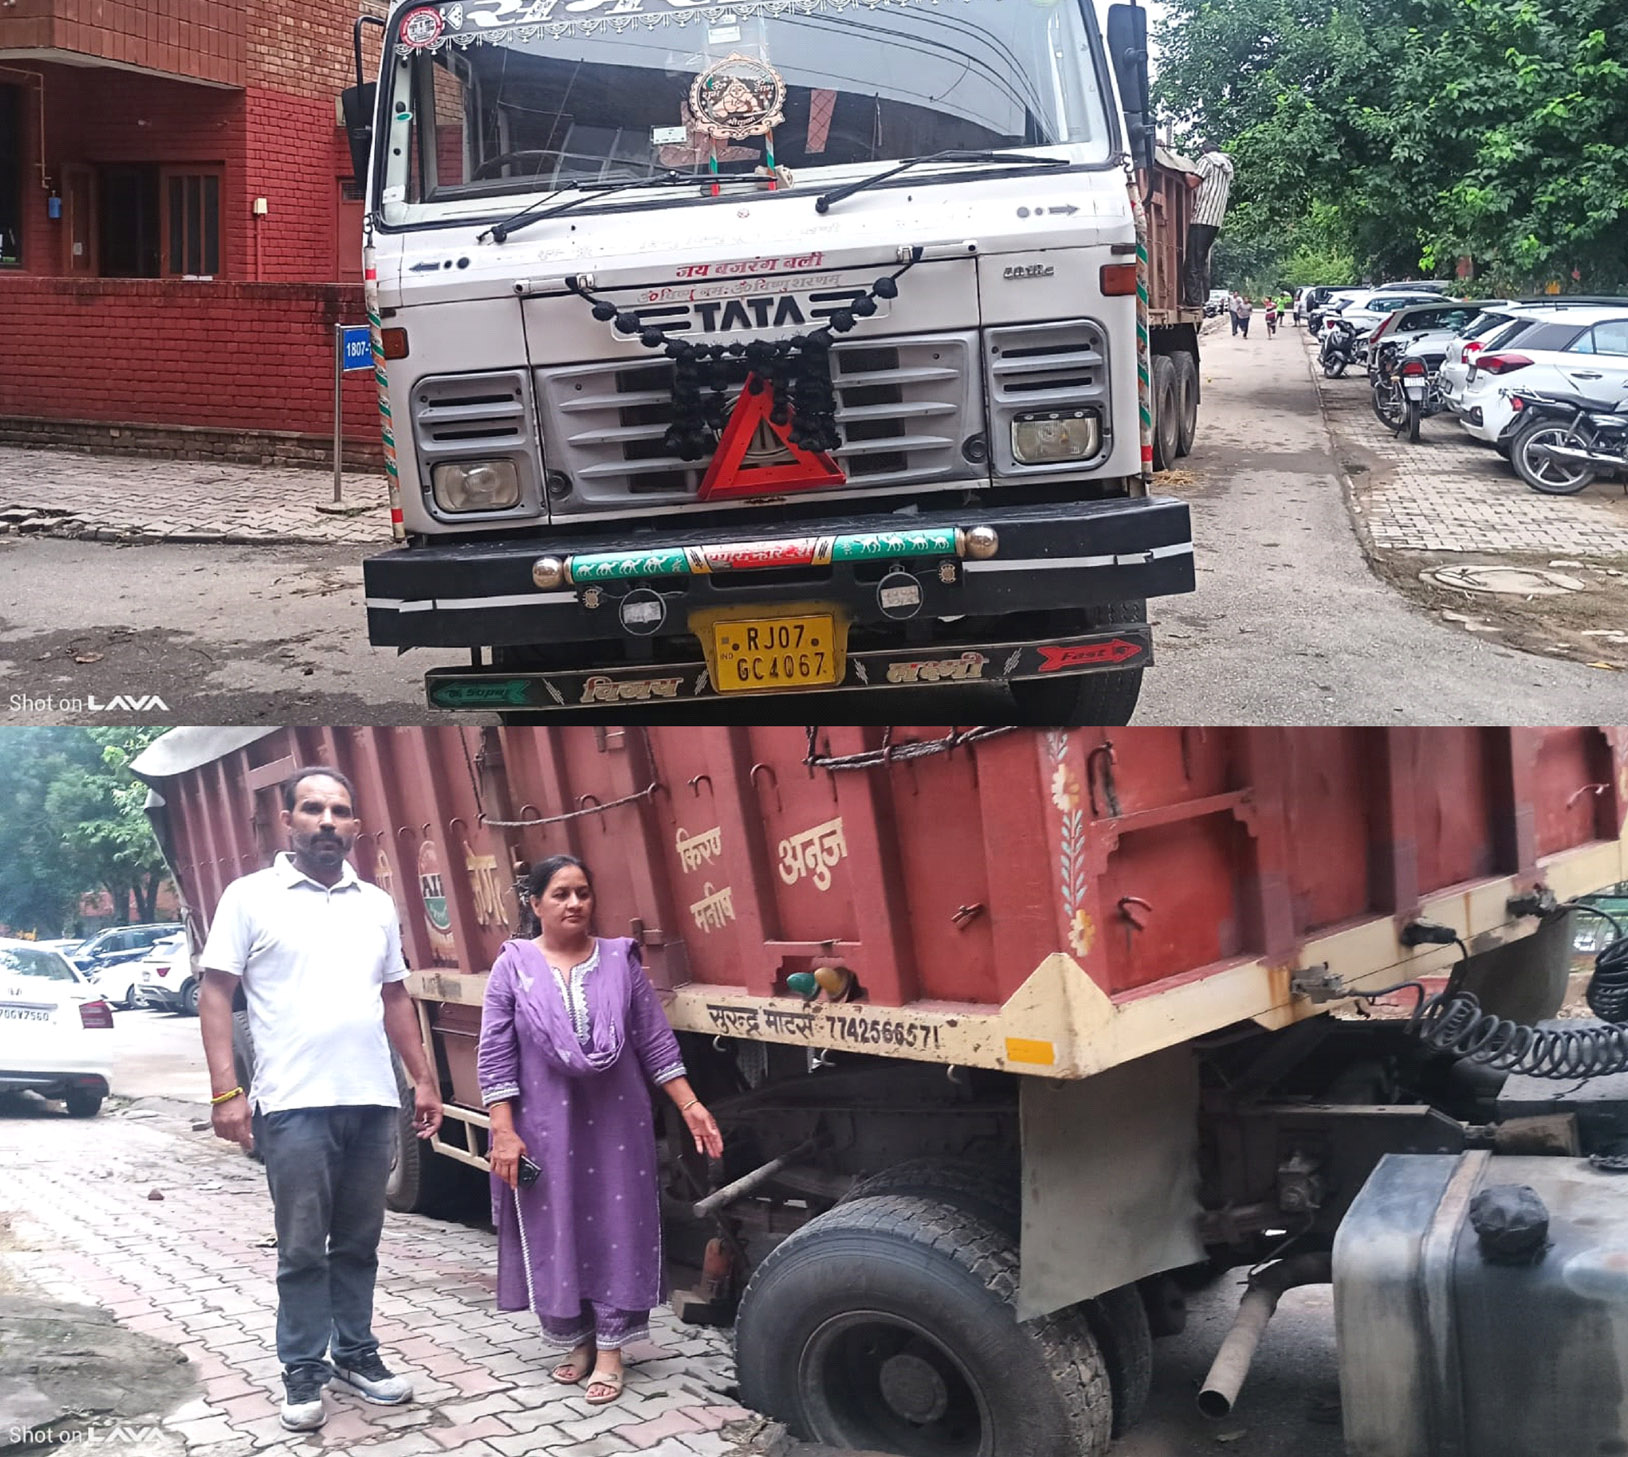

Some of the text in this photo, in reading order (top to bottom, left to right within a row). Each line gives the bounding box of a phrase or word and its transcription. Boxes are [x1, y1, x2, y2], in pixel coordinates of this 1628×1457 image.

[676, 251, 825, 278] जय बजरंग बली
[694, 295, 806, 333] TATA
[747, 624, 805, 651] RJ07
[737, 652, 825, 681] GC4067
[1062, 649, 1107, 662] Fast
[778, 816, 848, 892] अनुज
[825, 1014, 941, 1049] 7742566571
